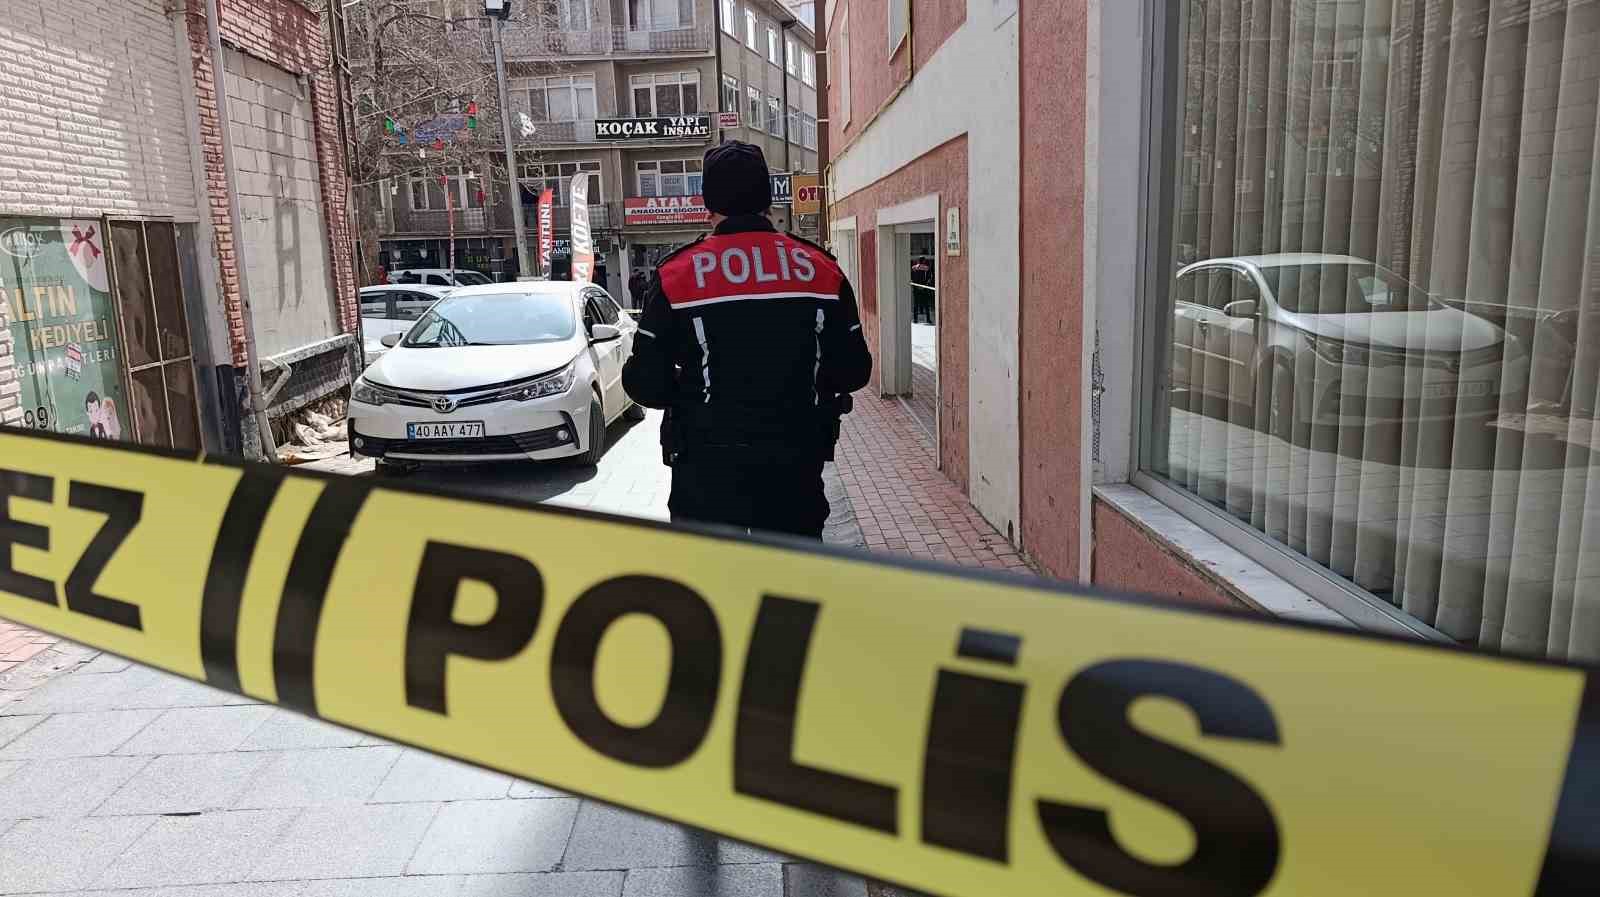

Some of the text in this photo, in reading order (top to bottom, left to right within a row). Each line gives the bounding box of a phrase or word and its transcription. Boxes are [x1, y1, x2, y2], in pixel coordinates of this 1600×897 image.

[670, 117, 700, 127] YAPI
[596, 121, 658, 138] KOÇAK
[663, 124, 708, 137] İNŞAAT
[647, 197, 693, 207] ATAK
[692, 241, 817, 289] POLİS
[415, 423, 481, 437] 40 AAY 477
[404, 538, 1283, 897] POLİS
